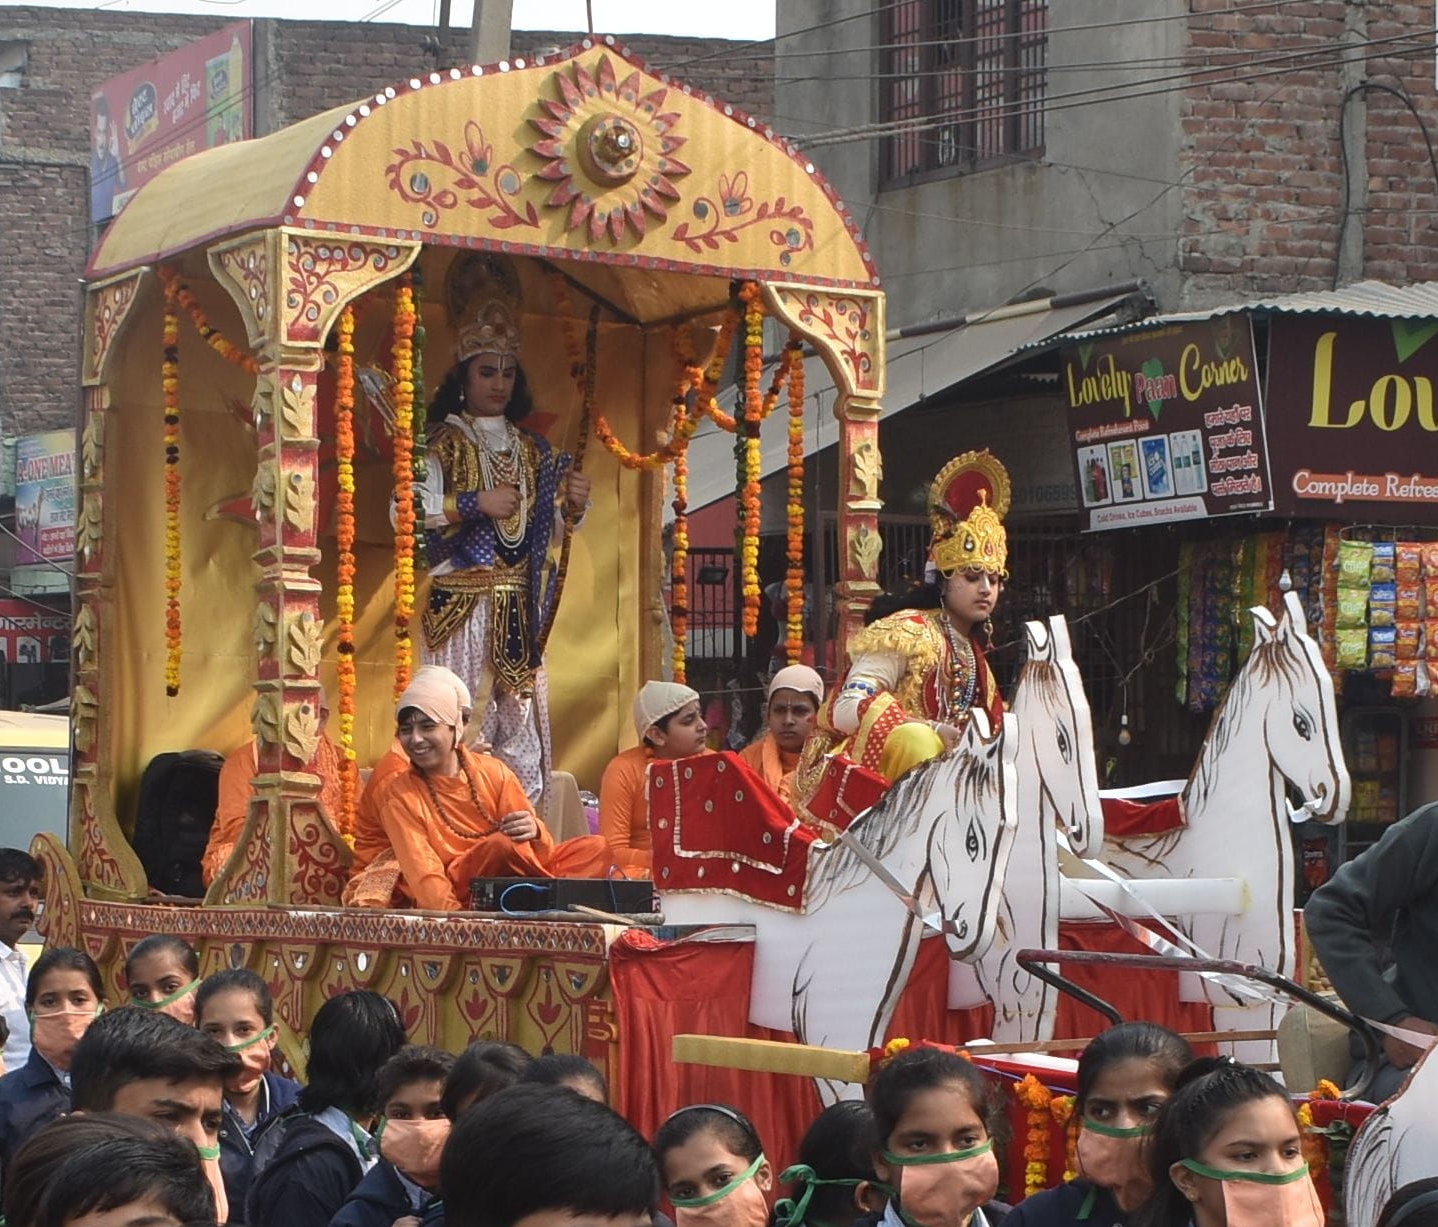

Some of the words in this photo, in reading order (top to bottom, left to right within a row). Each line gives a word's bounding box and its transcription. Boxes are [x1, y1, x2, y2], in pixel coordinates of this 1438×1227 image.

[1067, 353, 1132, 418] Lovely
[1135, 372, 1179, 404] Paan
[1179, 342, 1250, 402] Corner
[1291, 469, 1382, 503] Complete
[4, 775, 30, 785] S.D.
